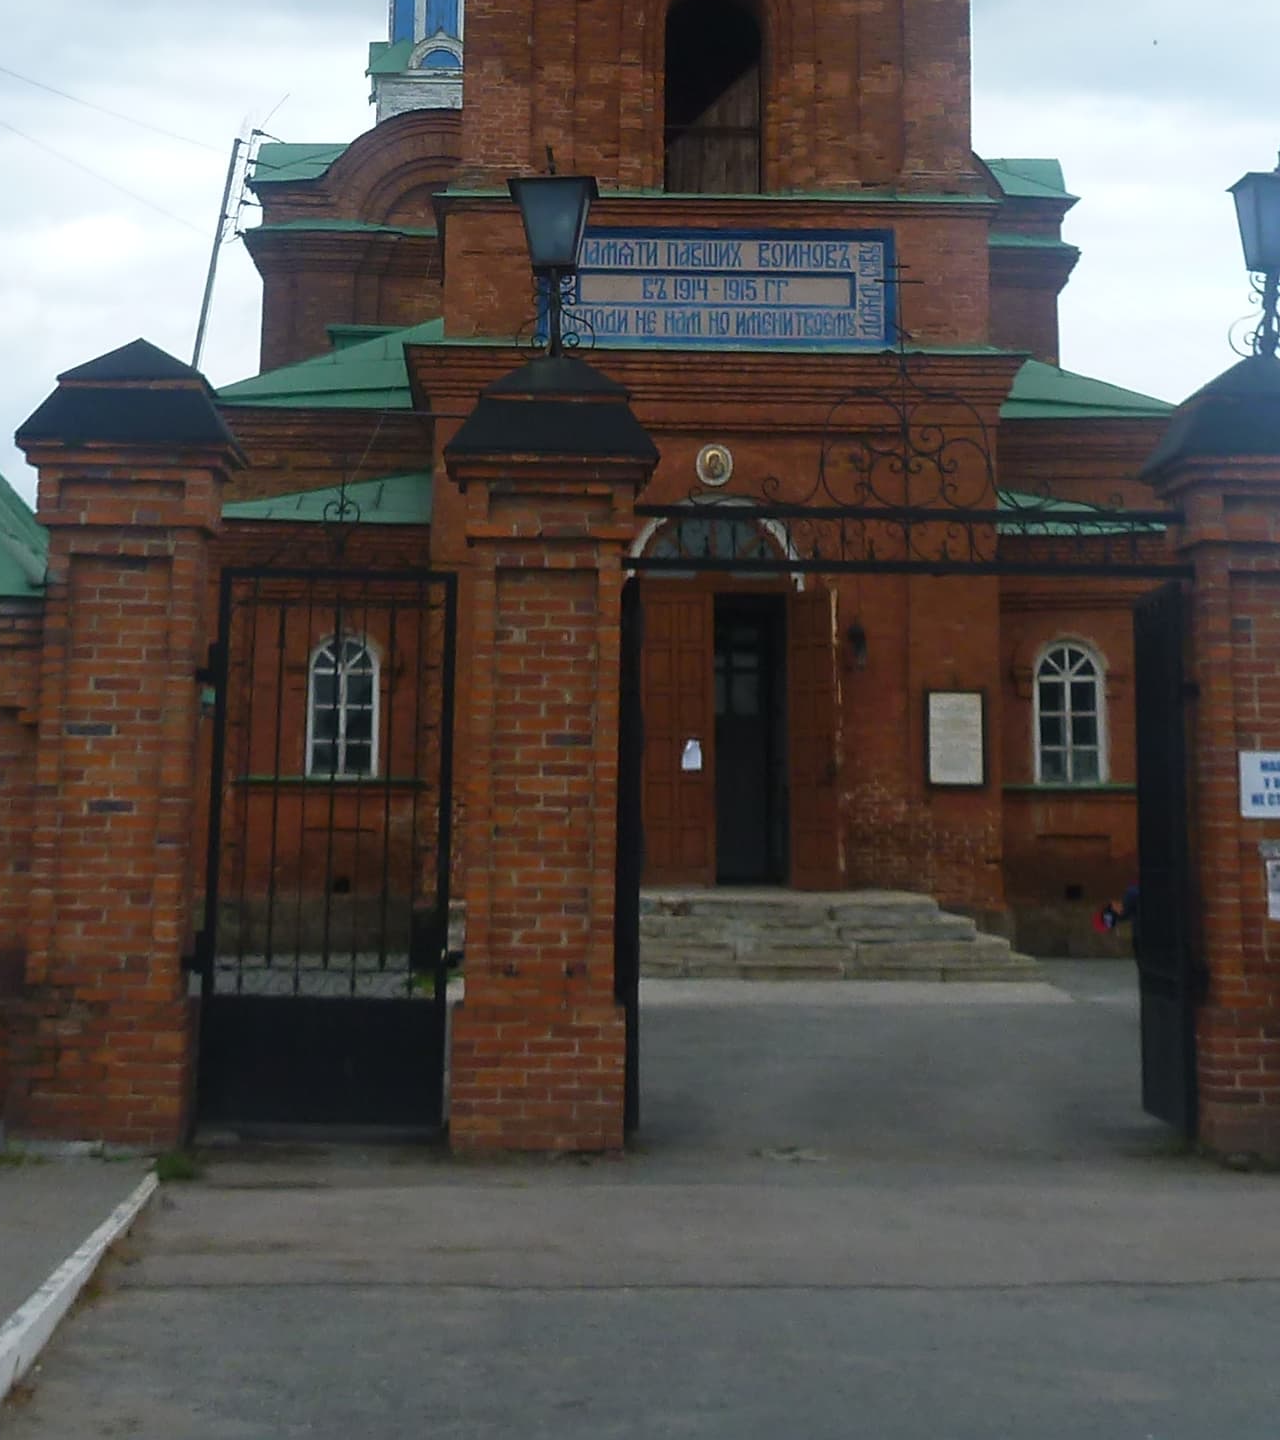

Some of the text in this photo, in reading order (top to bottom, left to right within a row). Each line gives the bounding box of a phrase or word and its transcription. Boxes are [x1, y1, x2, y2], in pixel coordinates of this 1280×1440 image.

[667, 243, 742, 268] ПАВШИХ
[674, 279, 708, 300] 1914
[723, 280, 757, 301] 1915
[635, 309, 656, 334] НЕ
[708, 311, 730, 335] НО
